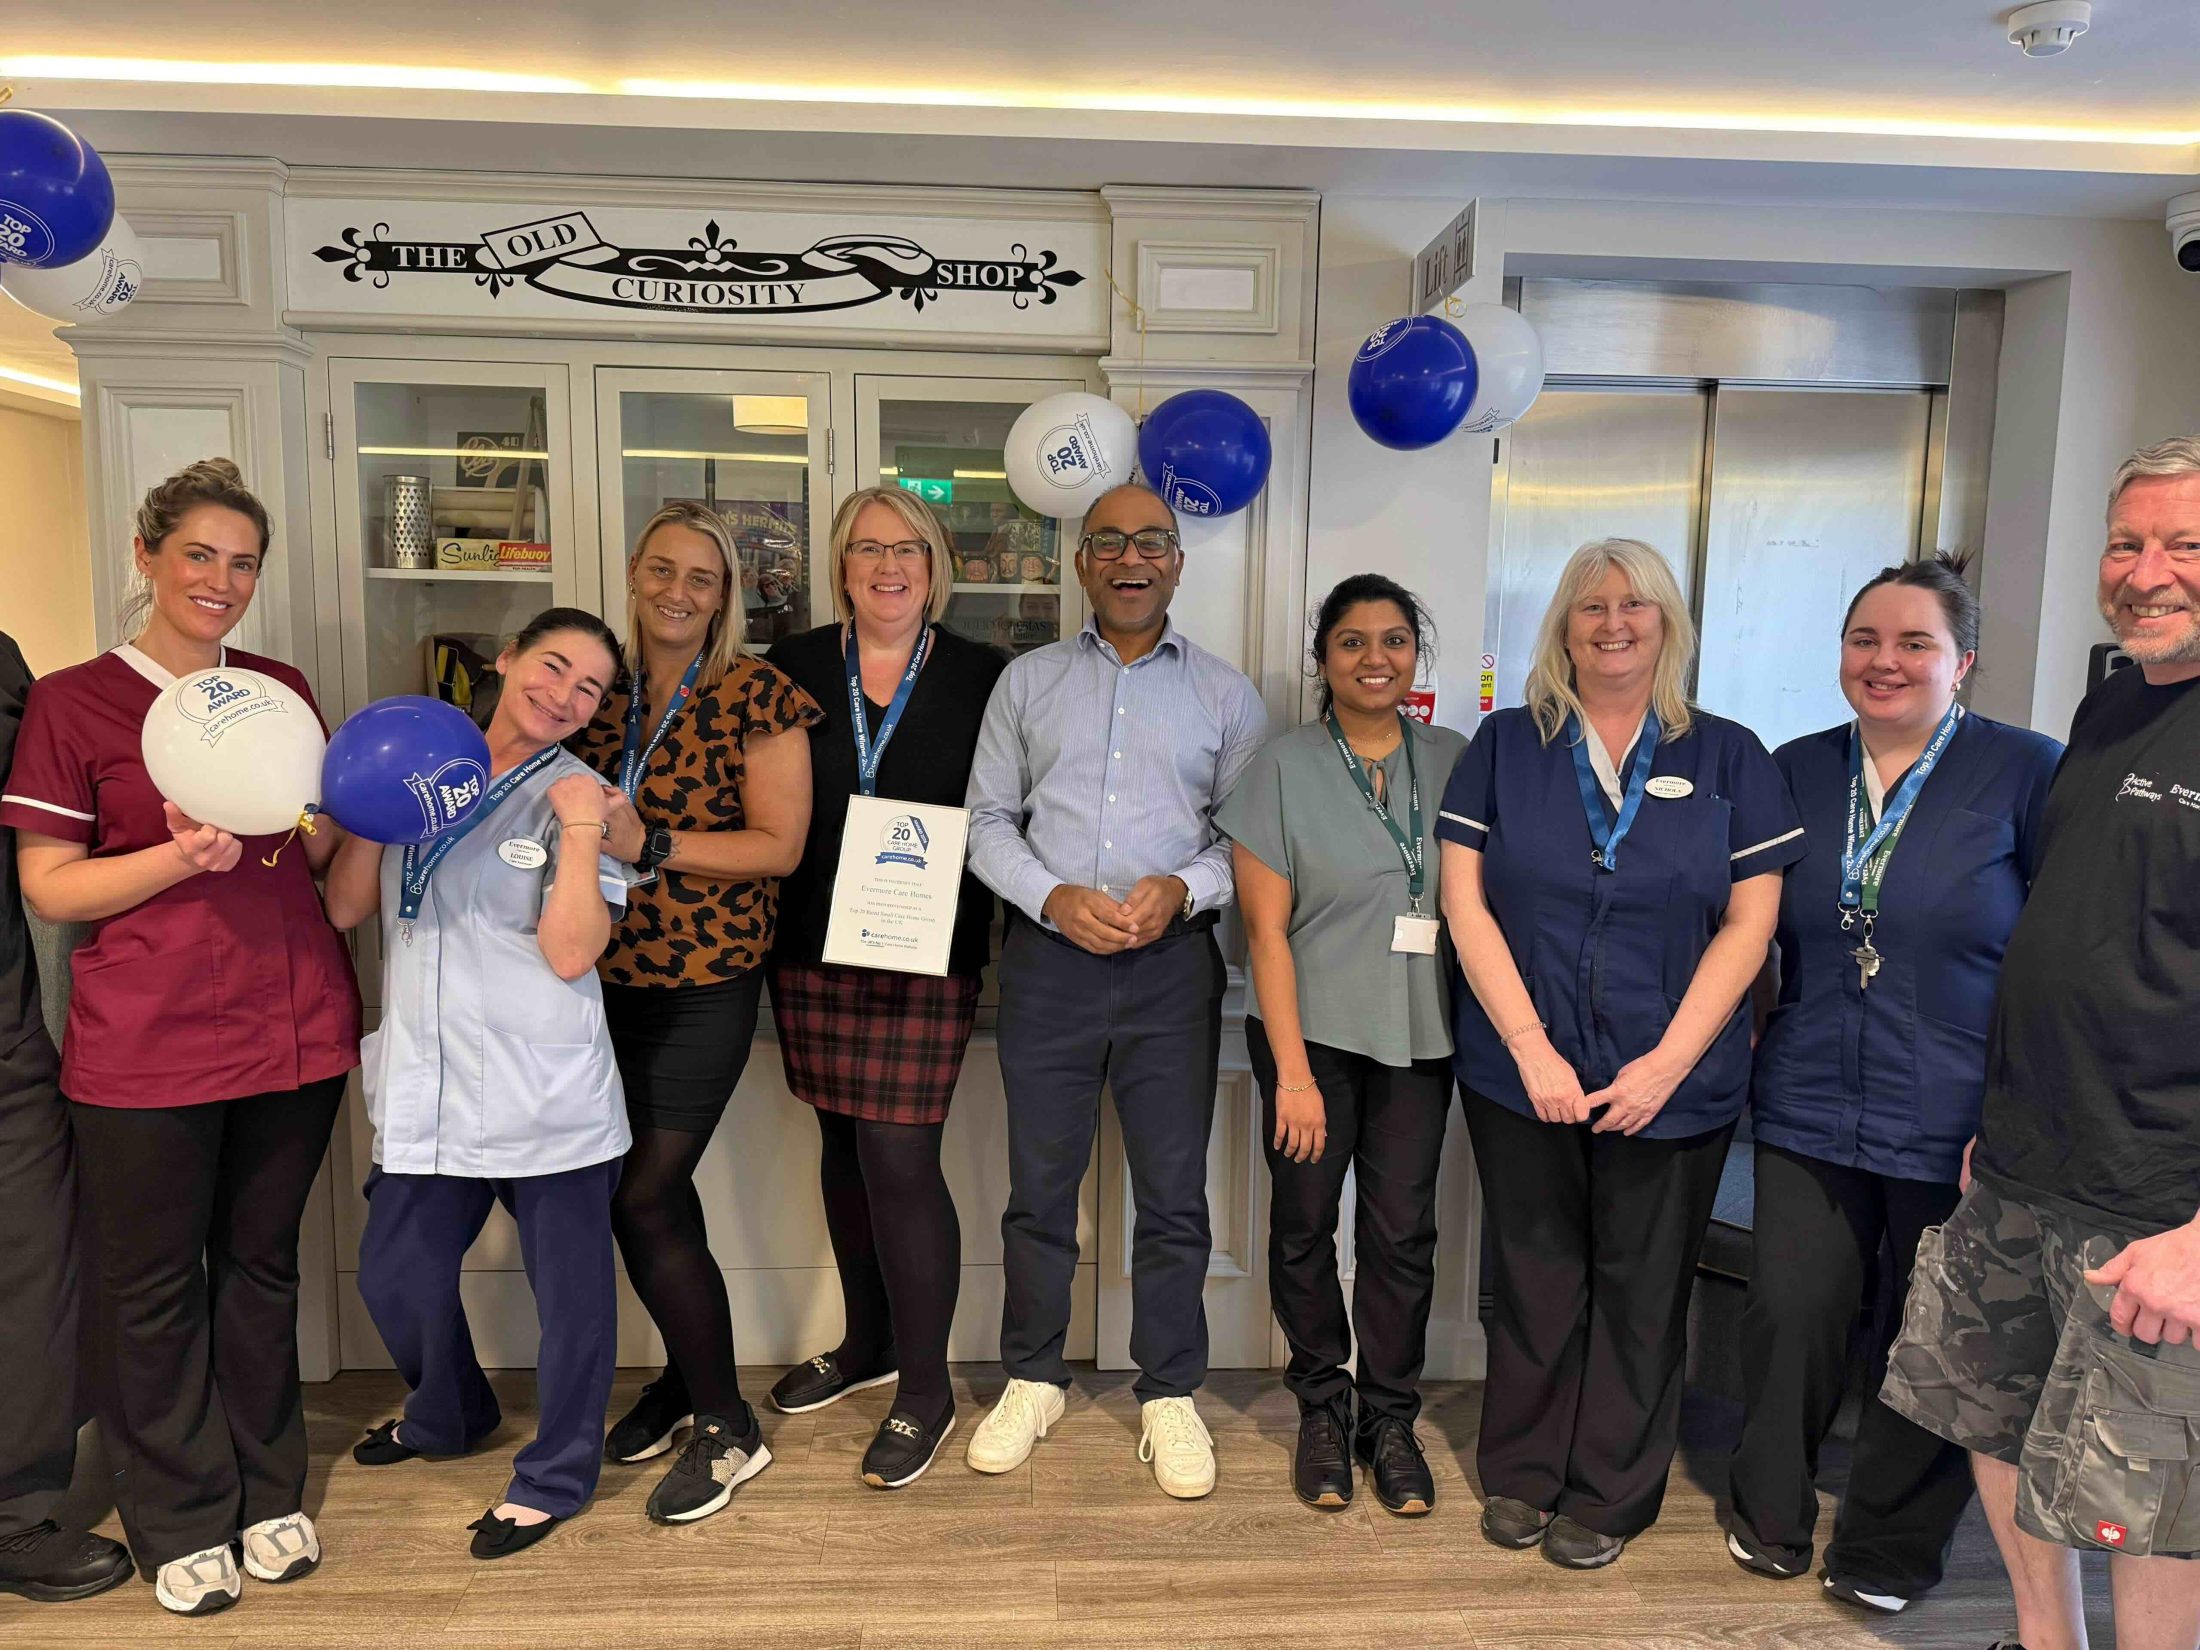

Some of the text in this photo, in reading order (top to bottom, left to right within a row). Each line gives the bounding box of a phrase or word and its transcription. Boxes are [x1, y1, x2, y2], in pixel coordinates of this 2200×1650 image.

[4, 213, 32, 234] TOP
[392, 223, 1024, 305] THE OLD CURIOSITY SHOP
[1424, 244, 1449, 299] Lift
[89, 259, 114, 305] carehome.co.uk
[106, 272, 126, 304] AWARD
[118, 282, 134, 301] 20
[1069, 435, 1088, 469] AWARD
[1080, 422, 1103, 471] carehome.co.uk
[1047, 454, 1061, 475] TOP
[1057, 446, 1077, 471] 20
[1183, 497, 1199, 513] 20
[500, 545, 550, 561] Lifebuoy
[911, 662, 918, 671] 20
[914, 651, 922, 664] Care
[193, 675, 220, 689] TOP
[850, 675, 858, 687] Top
[906, 670, 916, 681] Top
[201, 681, 233, 701] 20
[207, 689, 250, 713] AWARD
[852, 688, 859, 696] 20
[209, 700, 273, 733] carehome.co.uk
[661, 719, 670, 729] 20
[666, 708, 677, 720] Top
[855, 713, 863, 733] Home
[858, 734, 867, 757] Winner
[871, 724, 893, 768] carehome.co.uk
[1337, 738, 1356, 769] Evermore
[1915, 761, 1929, 775] Top
[1924, 751, 1935, 762] 20
[1930, 735, 1945, 752] Care
[1940, 718, 1955, 737] Home
[469, 775, 480, 796] TOP
[489, 789, 504, 801] Top
[503, 782, 512, 791] 20
[511, 771, 525, 784] Care
[523, 758, 541, 773] Home
[1850, 774, 1858, 788] Top
[2131, 777, 2153, 788] Active
[439, 785, 457, 819] AWARD
[453, 782, 472, 807] 20
[1850, 788, 1857, 798] 20
[2129, 787, 2163, 802] Pathways
[419, 783, 439, 832] carehome.co.uk
[1849, 798, 1857, 813] Care
[891, 827, 911, 841] 20
[1847, 813, 1856, 834] Home
[1846, 834, 1855, 858] Winner
[1856, 822, 1892, 868] carehome.co.uk
[419, 836, 455, 885] carehome.co.uk
[881, 854, 922, 864] carehome.co.uk
[1400, 842, 1417, 876] Evermore
[1873, 850, 1891, 887] Evermore
[861, 885, 932, 900] Evermore Care Homes
